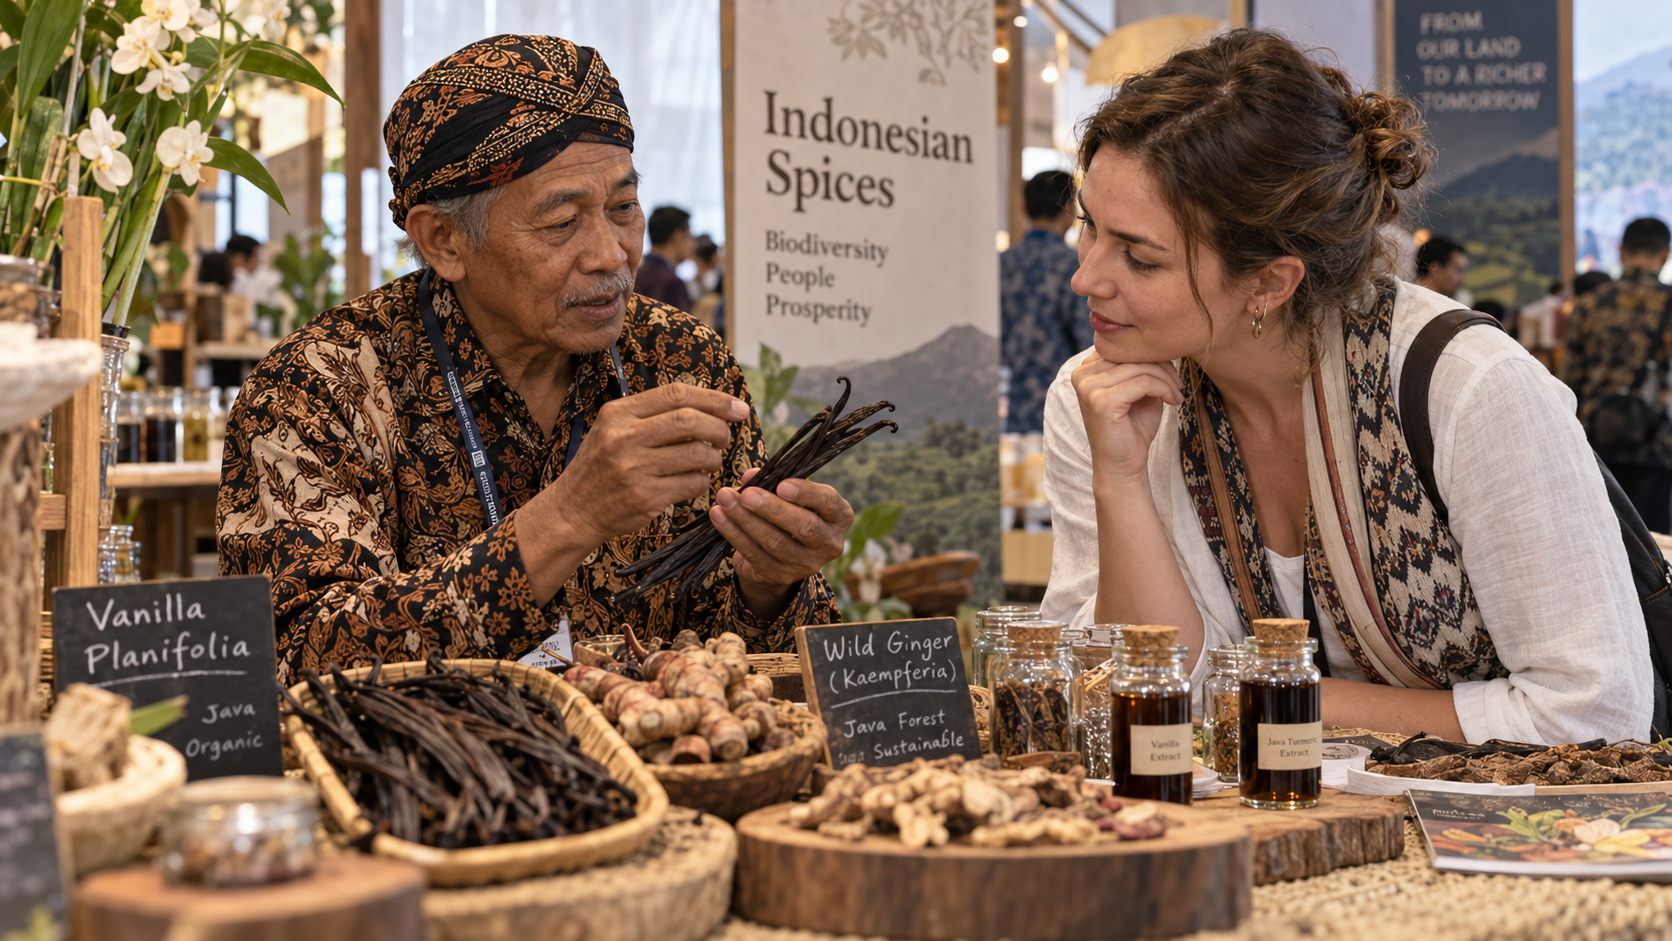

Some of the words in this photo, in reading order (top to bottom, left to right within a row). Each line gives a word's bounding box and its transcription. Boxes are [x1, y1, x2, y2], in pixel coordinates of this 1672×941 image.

[1420, 10, 1484, 34] FROM
[1416, 37, 1461, 60] OUR
[1464, 35, 1522, 60] LAND
[1420, 64, 1451, 86] TO
[1454, 64, 1471, 86] A
[1474, 61, 1548, 86] RICHER
[1418, 89, 1541, 114] TOMORROW
[763, 90, 974, 165] Indonesian
[766, 149, 895, 213] Spices
[765, 229, 889, 268] Biodiversity
[765, 262, 835, 292] People
[765, 294, 872, 328] Prosperity
[86, 593, 206, 631] Vanilla
[84, 631, 251, 675] Planifolia
[823, 632, 875, 662] Wild
[887, 631, 953, 661] Ginger
[829, 659, 957, 694] (Kaempferia)
[201, 702, 256, 724] Java
[843, 719, 887, 738] Java
[898, 709, 946, 730] Forest
[185, 731, 264, 761] Organic
[874, 729, 965, 759] Sustainable
[1150, 740, 1180, 749] Vanilla
[1150, 752, 1181, 761] Extract
[1268, 738, 1286, 746] Java
[1280, 749, 1309, 757] Extract
